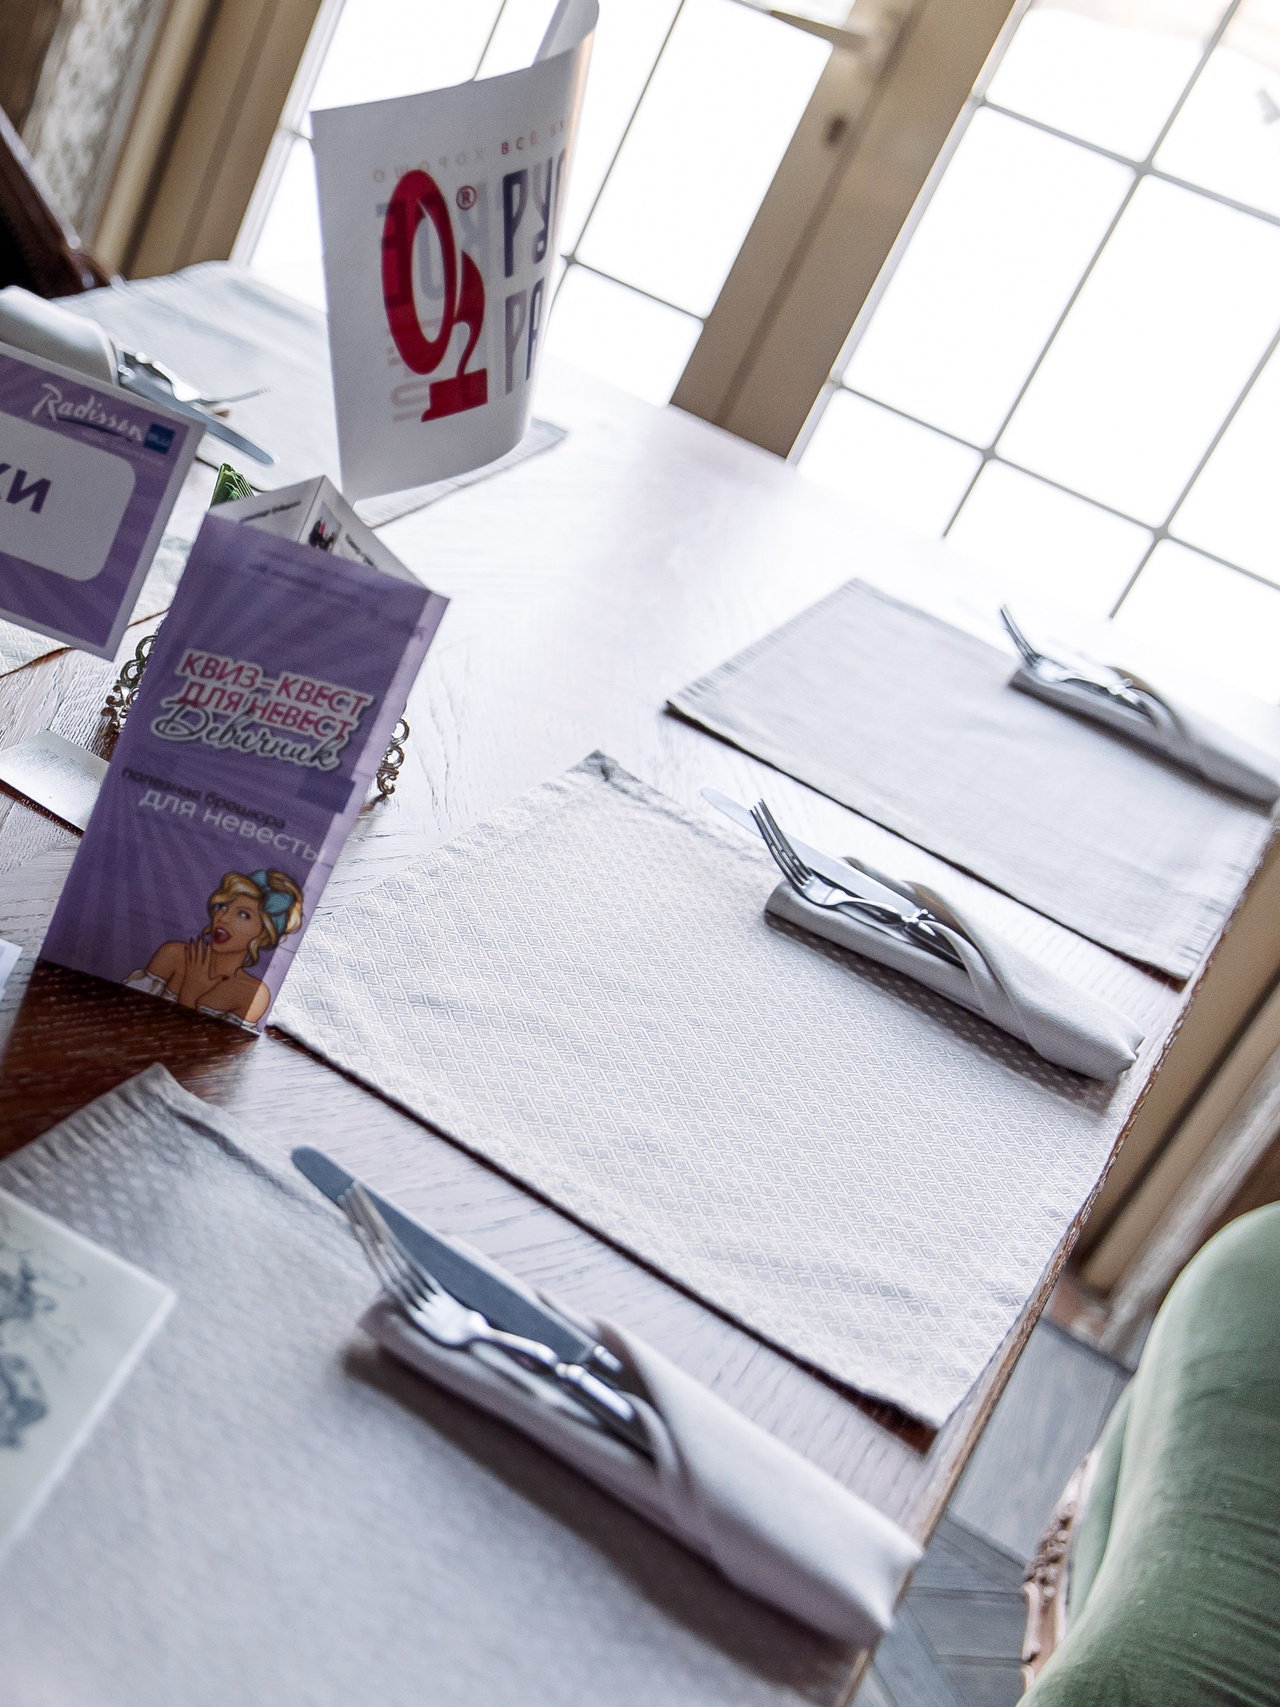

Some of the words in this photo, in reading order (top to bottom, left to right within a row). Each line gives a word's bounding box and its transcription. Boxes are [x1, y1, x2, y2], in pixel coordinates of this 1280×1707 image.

[31, 382, 143, 442] Radisson
[176, 681, 245, 715] ДЛЯ
[245, 700, 355, 742] НЕВЕСТ
[138, 789, 197, 819] для
[202, 808, 327, 863] невесты
